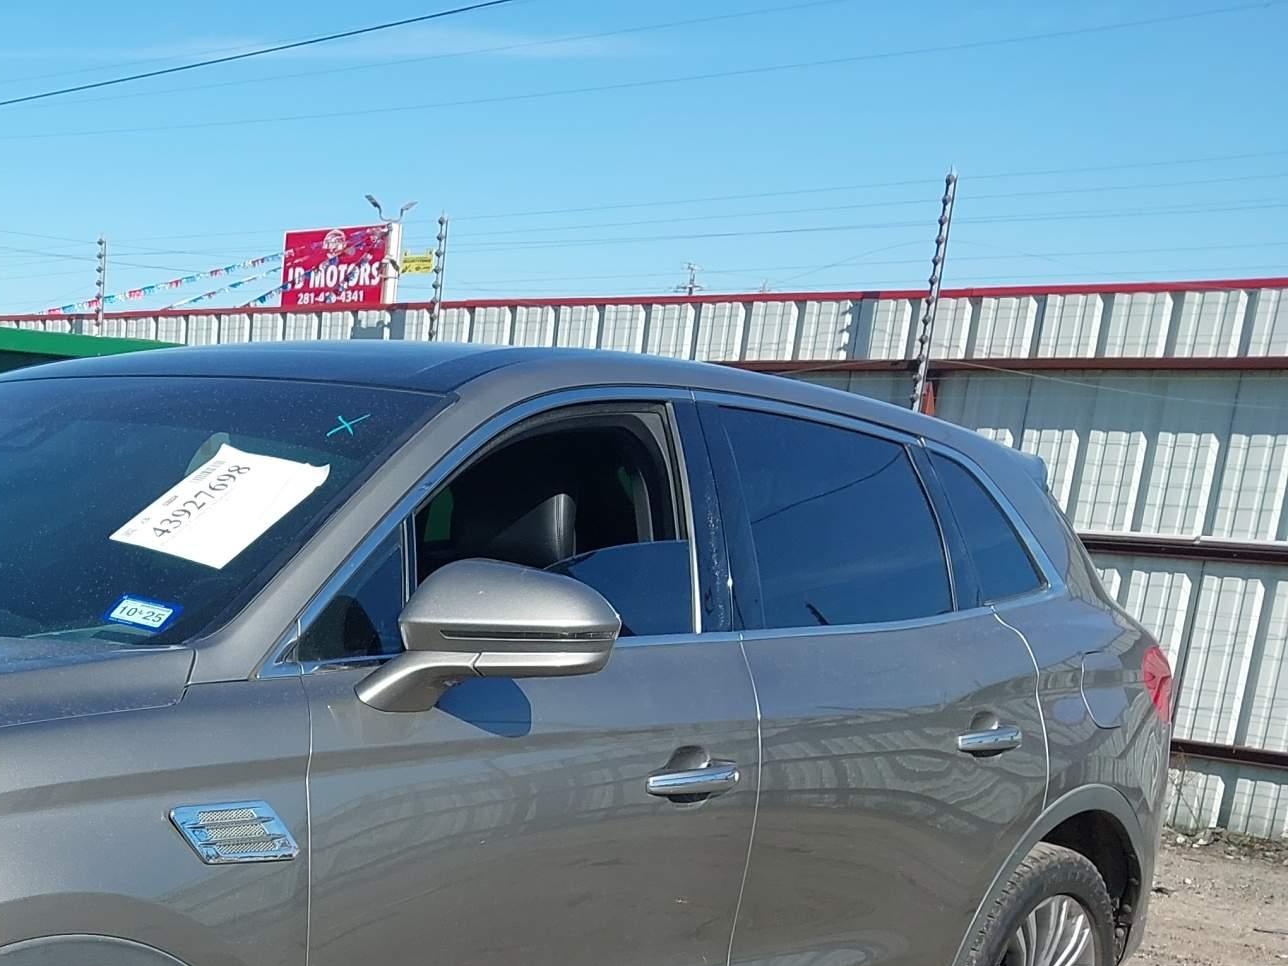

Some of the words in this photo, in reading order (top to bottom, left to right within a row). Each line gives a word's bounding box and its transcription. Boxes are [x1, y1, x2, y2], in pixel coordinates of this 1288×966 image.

[309, 261, 380, 289] MOTORS
[153, 465, 251, 538] 43927698
[119, 605, 138, 617] 10
[142, 610, 165, 622] 25
